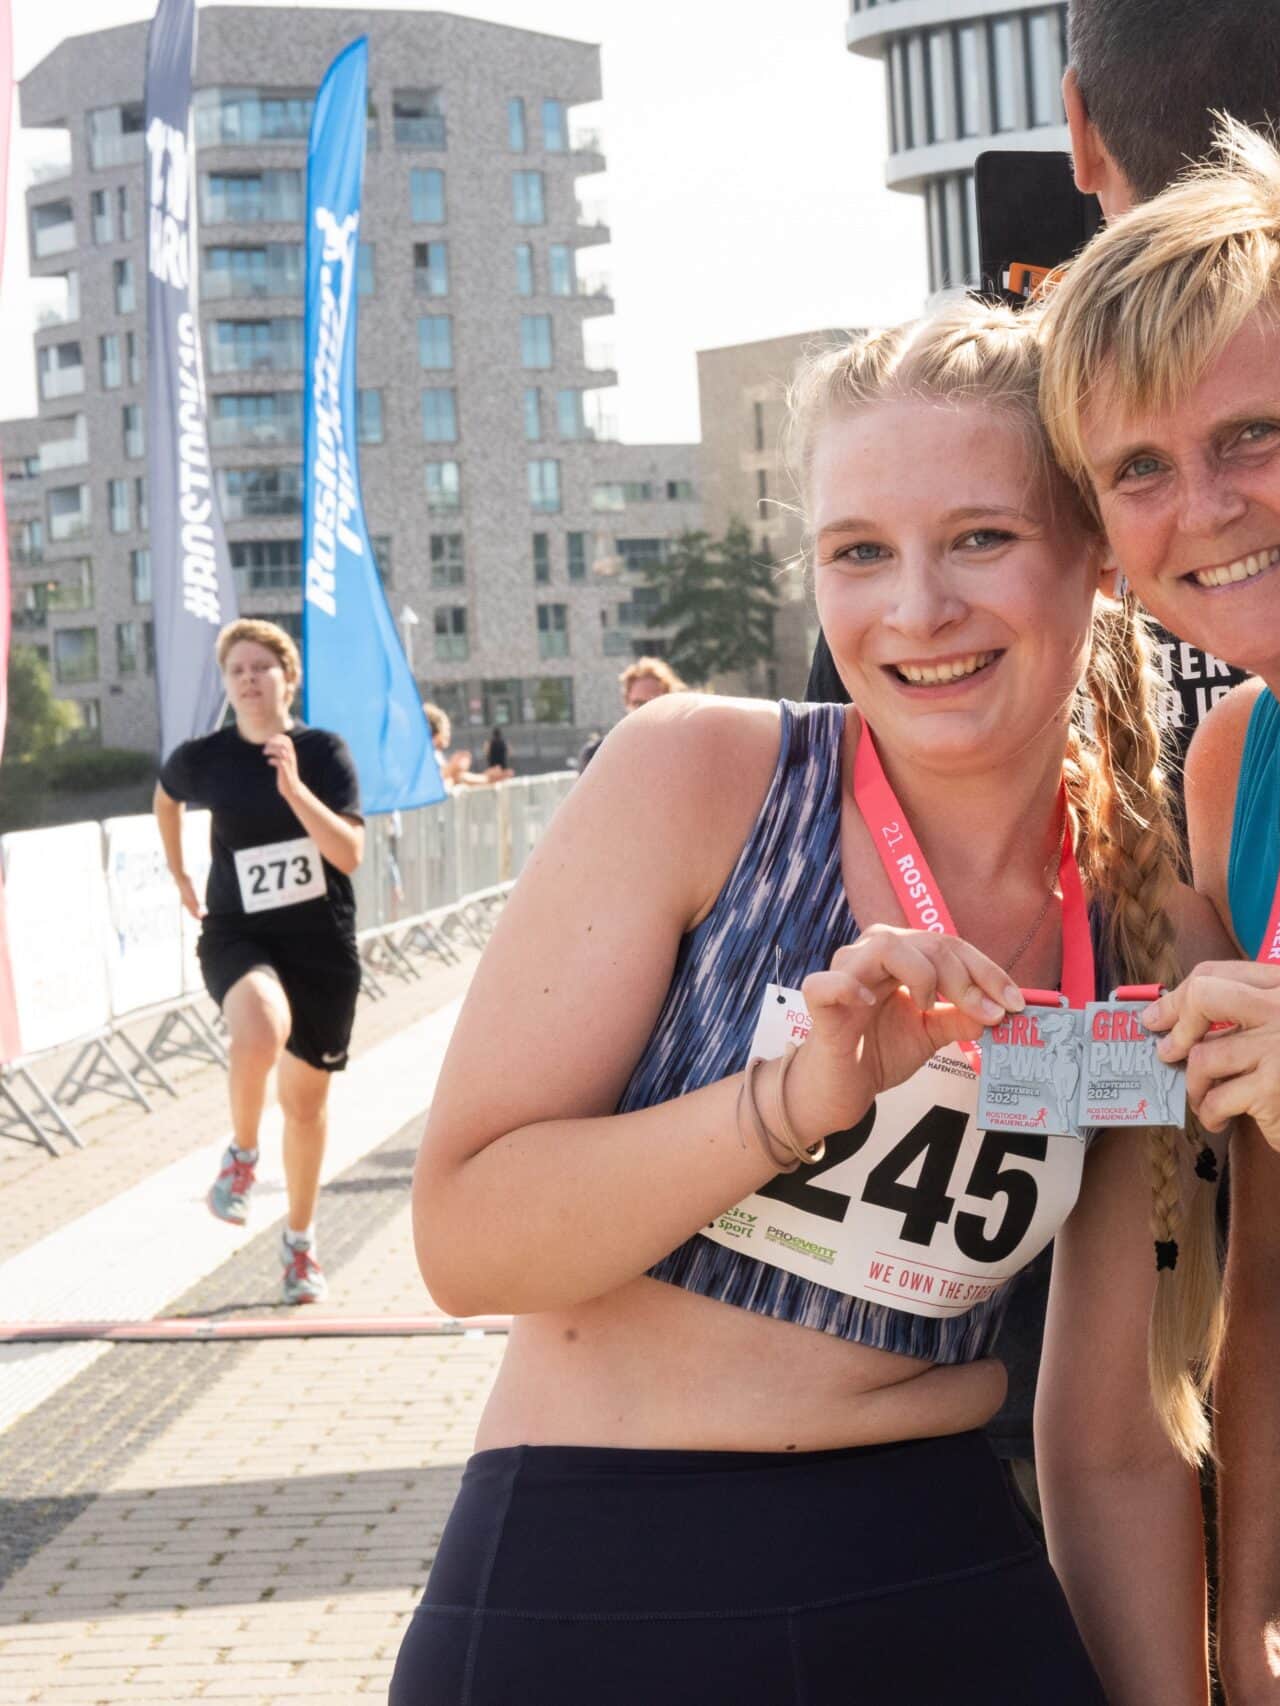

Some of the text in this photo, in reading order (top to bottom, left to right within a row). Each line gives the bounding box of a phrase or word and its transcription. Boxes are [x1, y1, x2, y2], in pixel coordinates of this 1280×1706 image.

[881, 821, 904, 853] 21.
[247, 855, 312, 895] 273
[992, 1014, 1045, 1048] GRL
[1092, 1009, 1146, 1042] GRL
[928, 1061, 950, 1073] HAFEN
[986, 1092, 1019, 1105] 2024
[1087, 1089, 1118, 1100] 2024
[986, 1111, 1028, 1121] ROSTOCKER
[990, 1119, 1040, 1128] FRAUENLAUF
[1091, 1113, 1139, 1121] FRAUENLAUF
[755, 1098, 1047, 1264] 245
[868, 1261, 894, 1284] WE
[899, 1269, 934, 1295] OWN
[938, 1279, 962, 1301] THE
